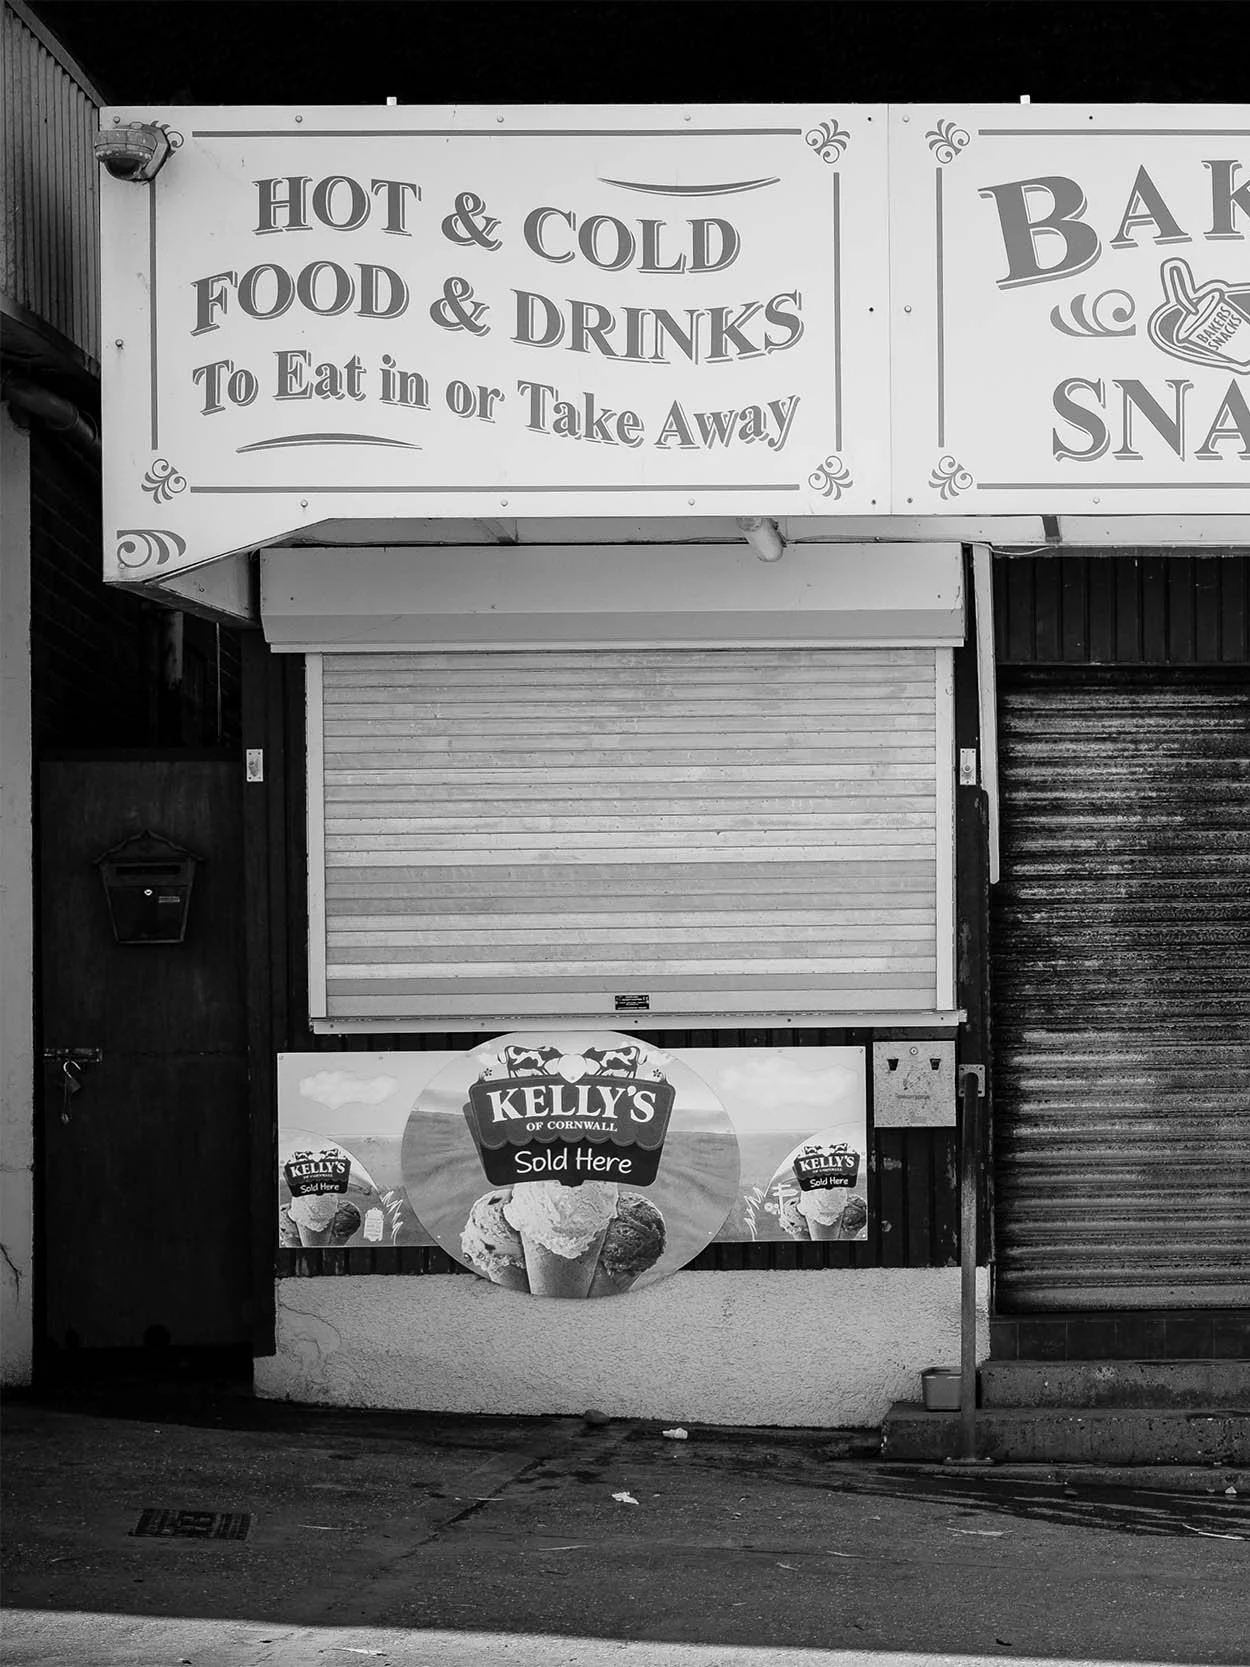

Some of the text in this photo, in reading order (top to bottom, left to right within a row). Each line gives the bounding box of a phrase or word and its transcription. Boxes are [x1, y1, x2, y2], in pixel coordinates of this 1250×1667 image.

[252, 176, 740, 274] HOT & COLD
[190, 261, 804, 365] FOOD & DRINKS
[1197, 306, 1231, 343] BAKERS
[1208, 316, 1242, 350] SNACKS
[193, 350, 800, 452] To Eat in or Take Away
[486, 1085, 656, 1123] KELLY'S
[526, 1120, 618, 1132] OF CORNWALL
[290, 1161, 345, 1178] KELLY'S
[514, 1147, 632, 1174] Sold Here
[800, 1155, 855, 1171] KELLY'S
[300, 1182, 340, 1193] Sold Here
[810, 1177, 849, 1187] Sold Here
